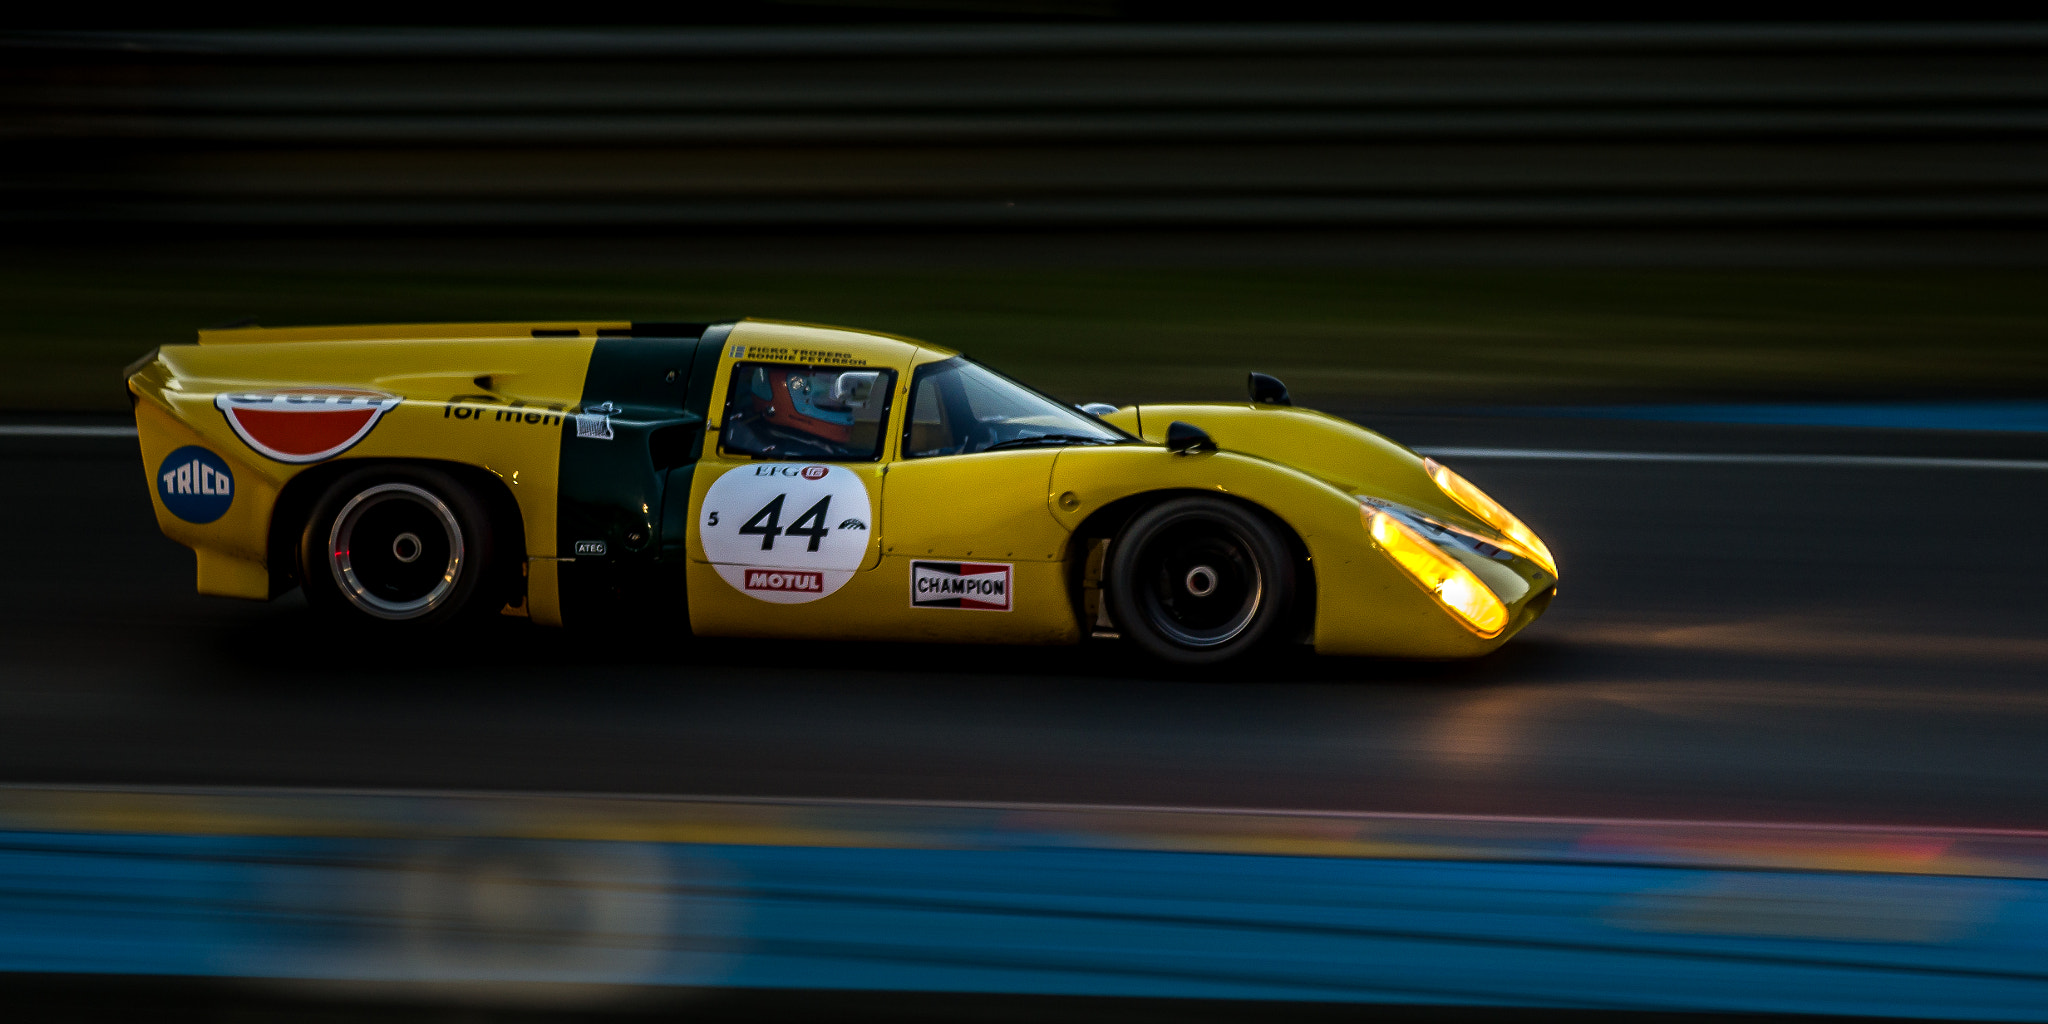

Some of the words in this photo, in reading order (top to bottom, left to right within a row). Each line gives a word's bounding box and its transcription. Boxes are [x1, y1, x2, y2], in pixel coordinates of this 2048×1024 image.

[747, 353, 796, 361] RONNIE
[799, 355, 867, 365] PETERSON
[495, 406, 562, 425] men
[163, 458, 230, 496] TRICO
[754, 465, 800, 477] EFG
[707, 511, 719, 526] 5
[738, 493, 833, 552] 44
[578, 543, 604, 553] ATEC
[747, 572, 820, 590] MOTUL
[917, 577, 1005, 595] CHAMPION
